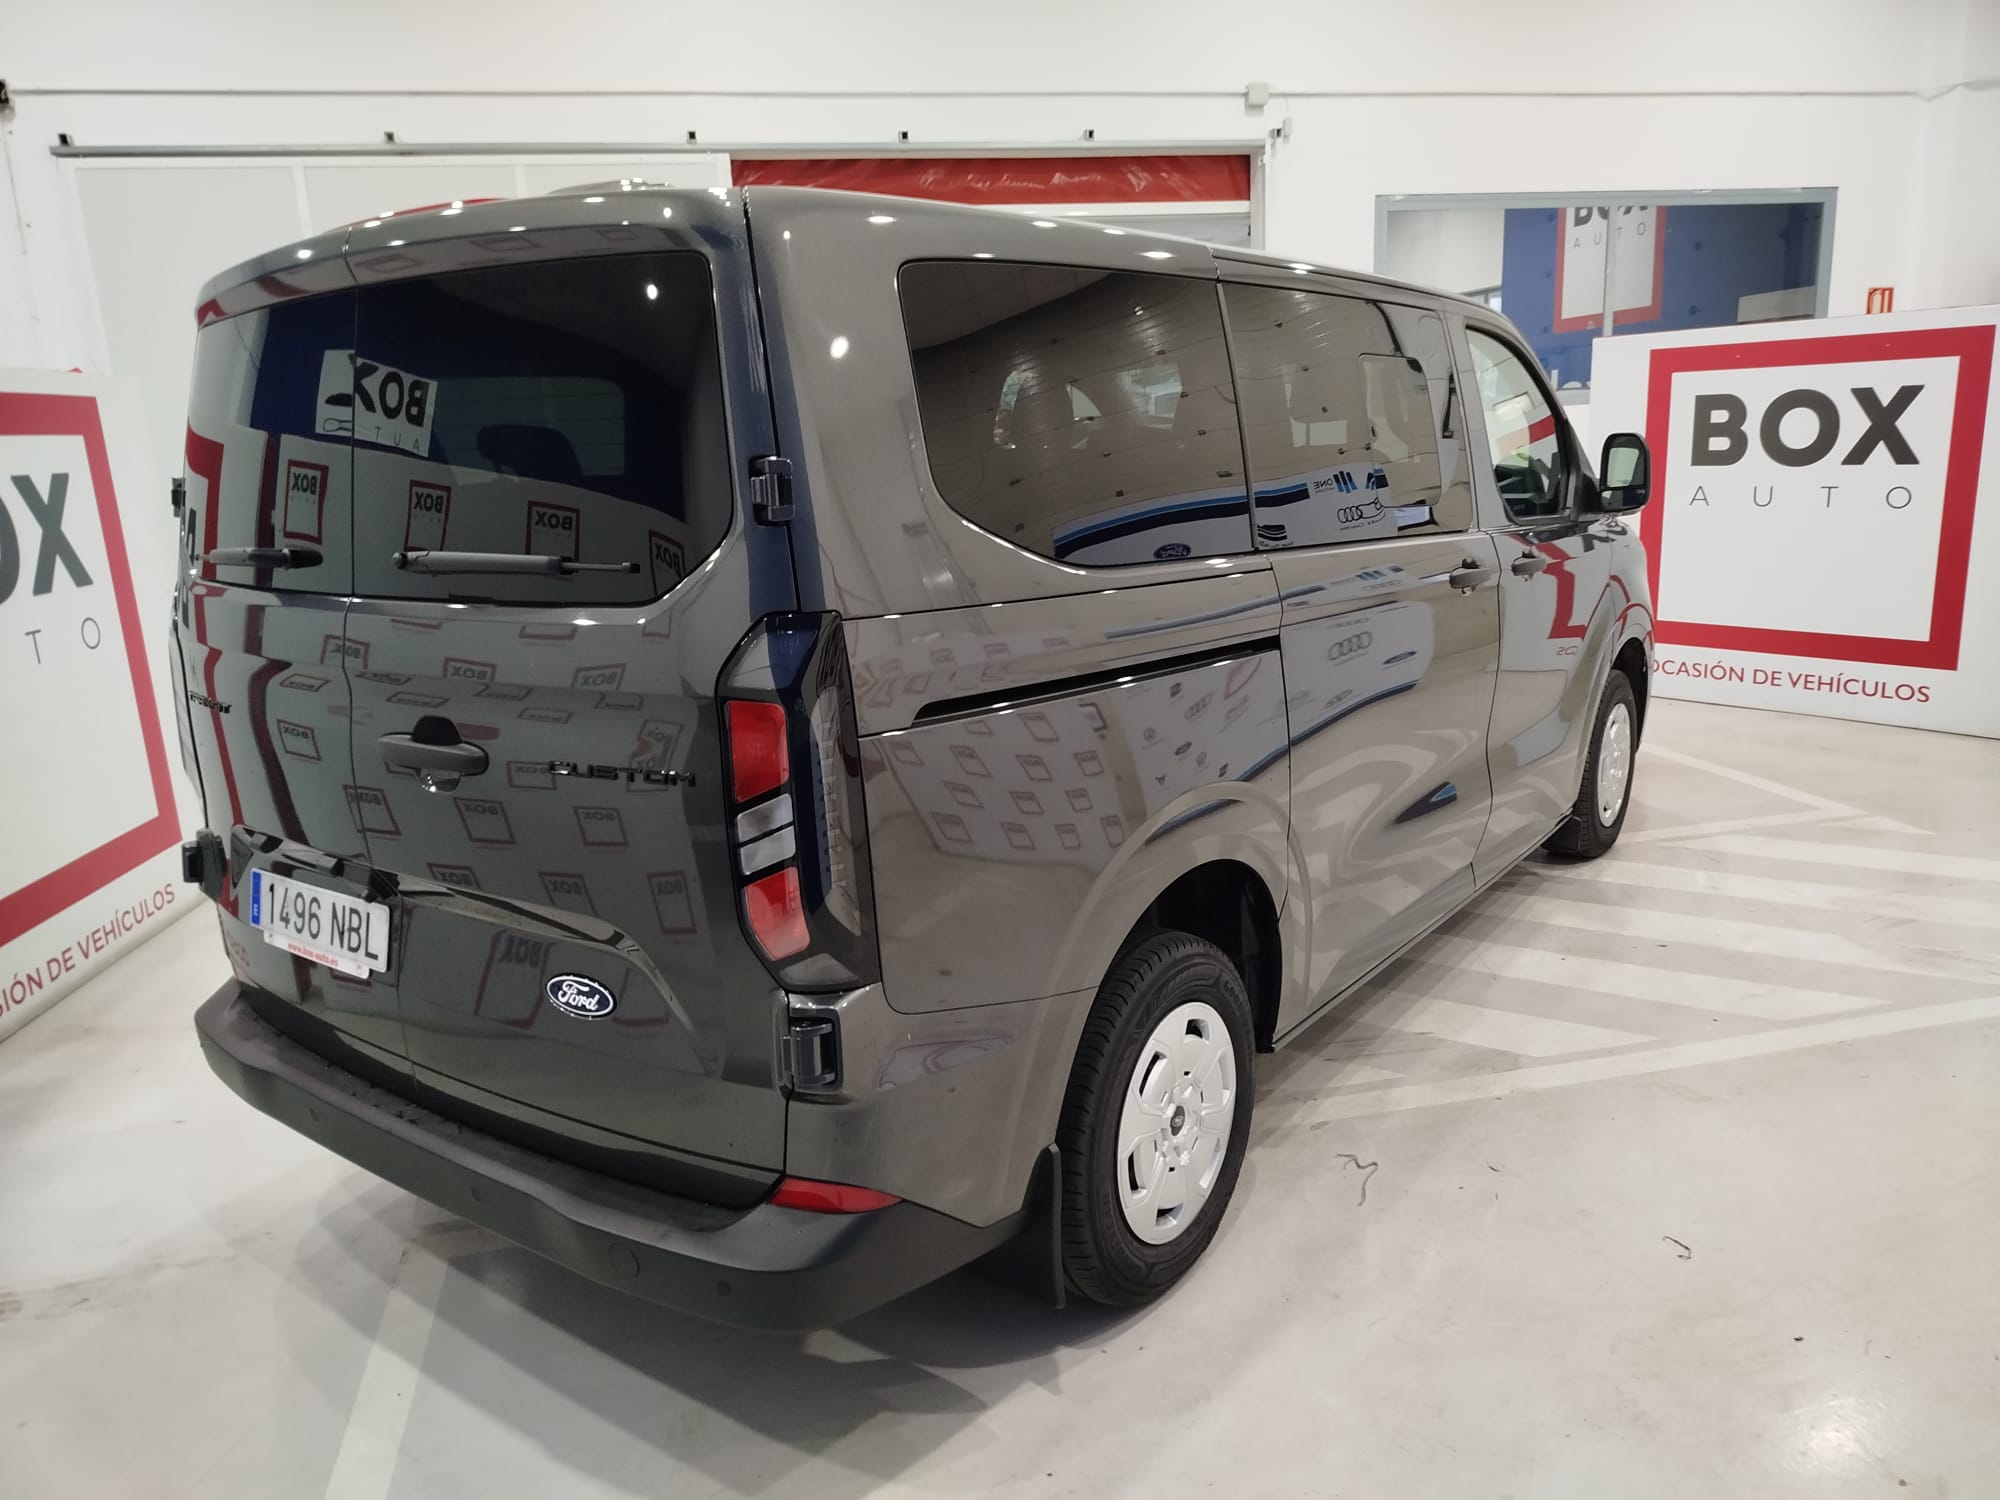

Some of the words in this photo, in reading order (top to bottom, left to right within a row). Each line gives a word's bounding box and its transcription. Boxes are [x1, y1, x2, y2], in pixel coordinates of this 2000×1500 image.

[1691, 384, 1925, 467] BOX
[1689, 485, 1912, 509] AUTO
[1752, 668, 1782, 687] DE
[1787, 672, 1930, 703] VEHÍCULOS
[550, 761, 696, 787] CUSTOM
[46, 947, 76, 983] DE
[77, 883, 176, 960] VEHÍCULOS
[269, 883, 321, 940] 1496
[330, 902, 379, 961] NBL
